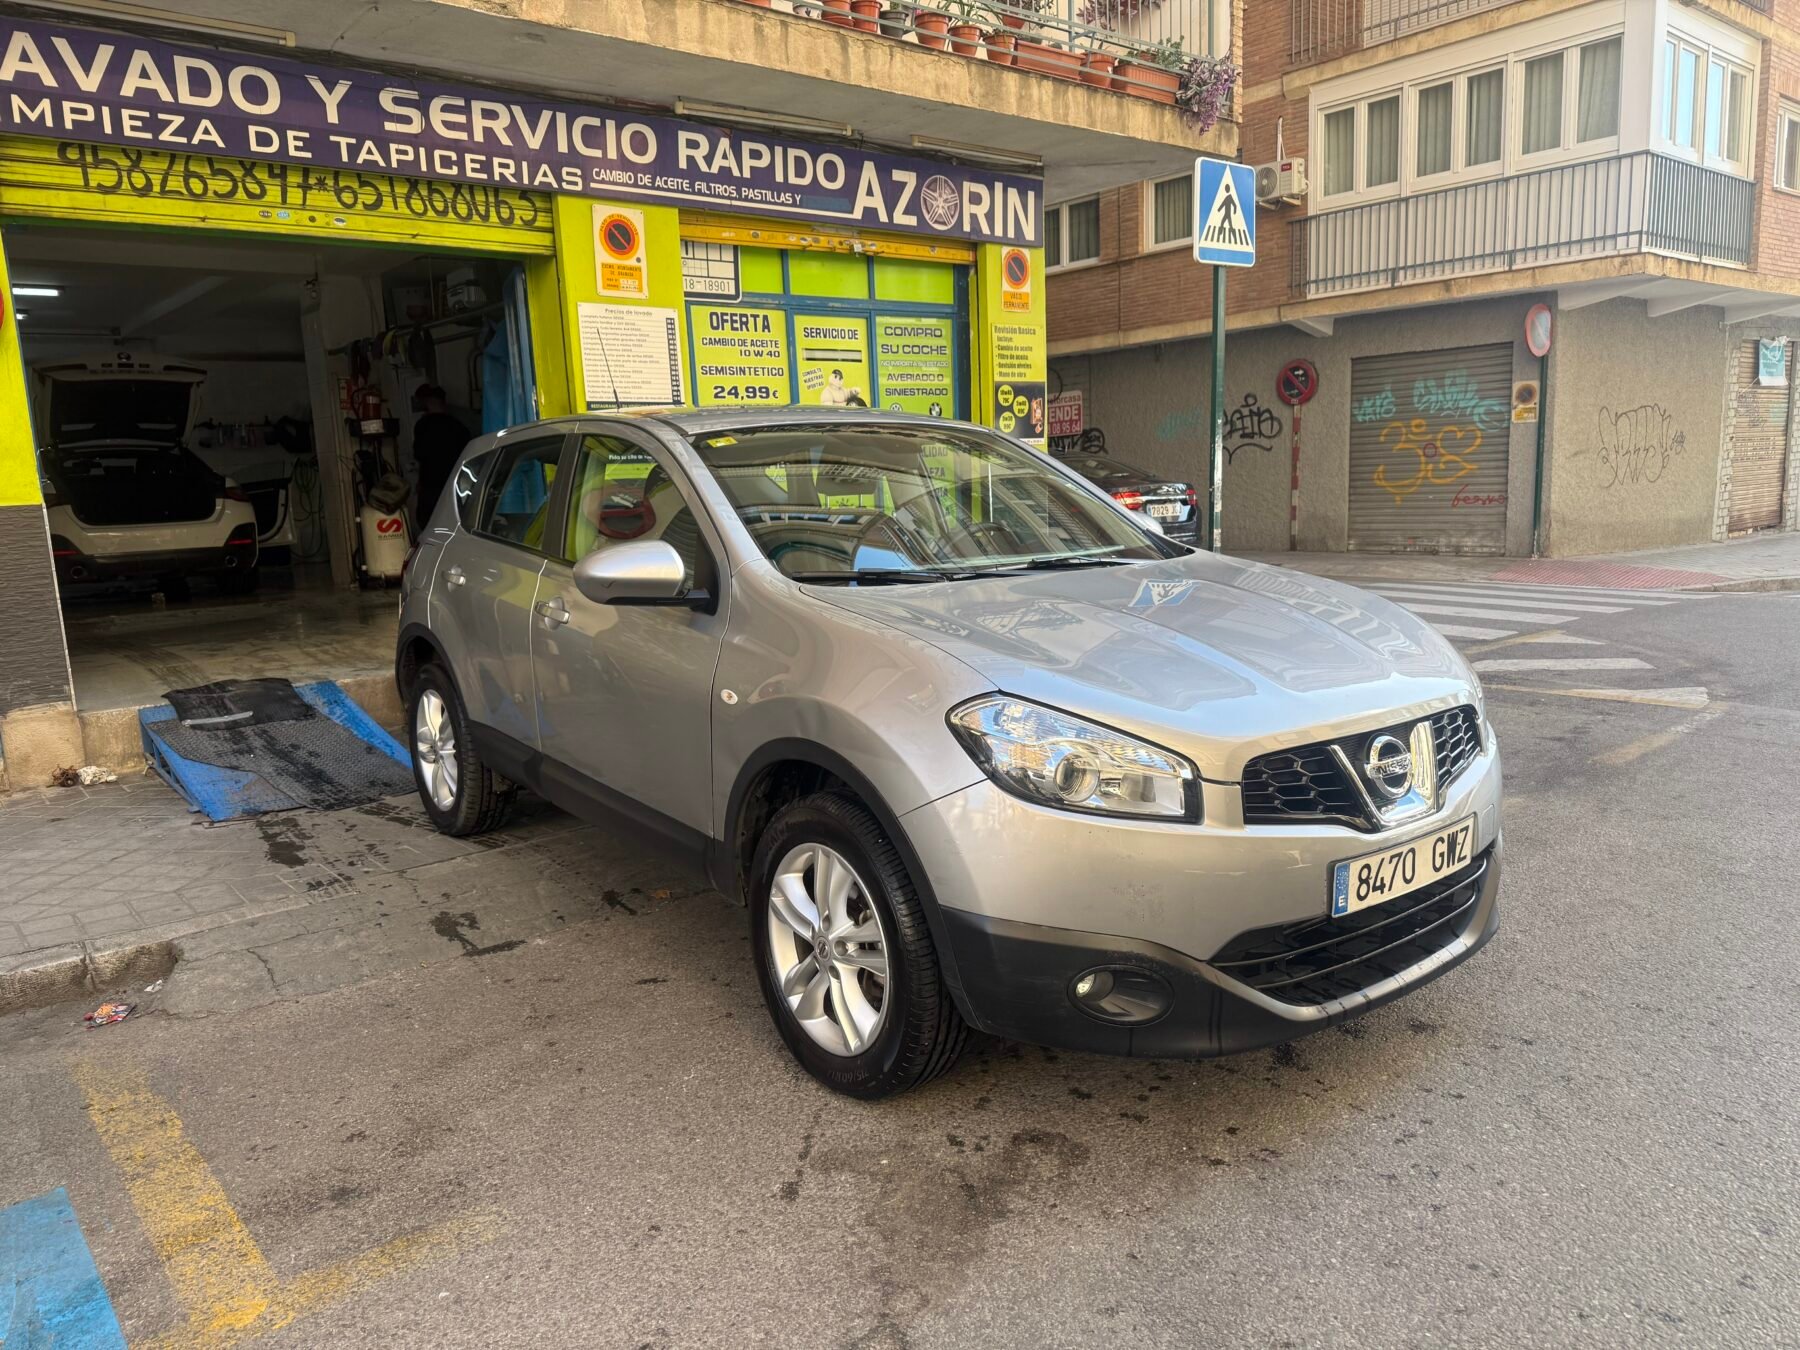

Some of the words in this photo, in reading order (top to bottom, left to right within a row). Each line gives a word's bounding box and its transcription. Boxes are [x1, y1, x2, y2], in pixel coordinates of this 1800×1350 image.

[304, 74, 352, 124] Y
[378, 87, 658, 165] SERVICIO
[677, 129, 846, 191] RAPIDO
[0, 94, 226, 148] MPIEZA
[247, 125, 313, 158] DE
[329, 135, 583, 191] TAPICERIAS
[592, 167, 635, 185] CAMBIO
[637, 173, 652, 186] DE
[741, 188, 793, 204] PASTILLAS
[794, 193, 802, 205] Y
[709, 311, 771, 333] OFERTA
[803, 327, 846, 340] SERVICIO
[847, 328, 859, 340] DE
[884, 326, 943, 338] COMPRO
[701, 337, 736, 347] CAMBIO
[737, 338, 749, 348] DE
[750, 339, 780, 348] ACEITE
[881, 344, 900, 354] SU
[902, 344, 948, 355] COCHE
[700, 365, 784, 377] SEMISINTETICO
[887, 373, 935, 382] AVERIADO
[936, 374, 944, 382] O
[885, 388, 948, 397] SINIESTRADO
[1356, 847, 1416, 902] 8470
[1431, 825, 1471, 874] GWZ
[1338, 895, 1346, 907] E
